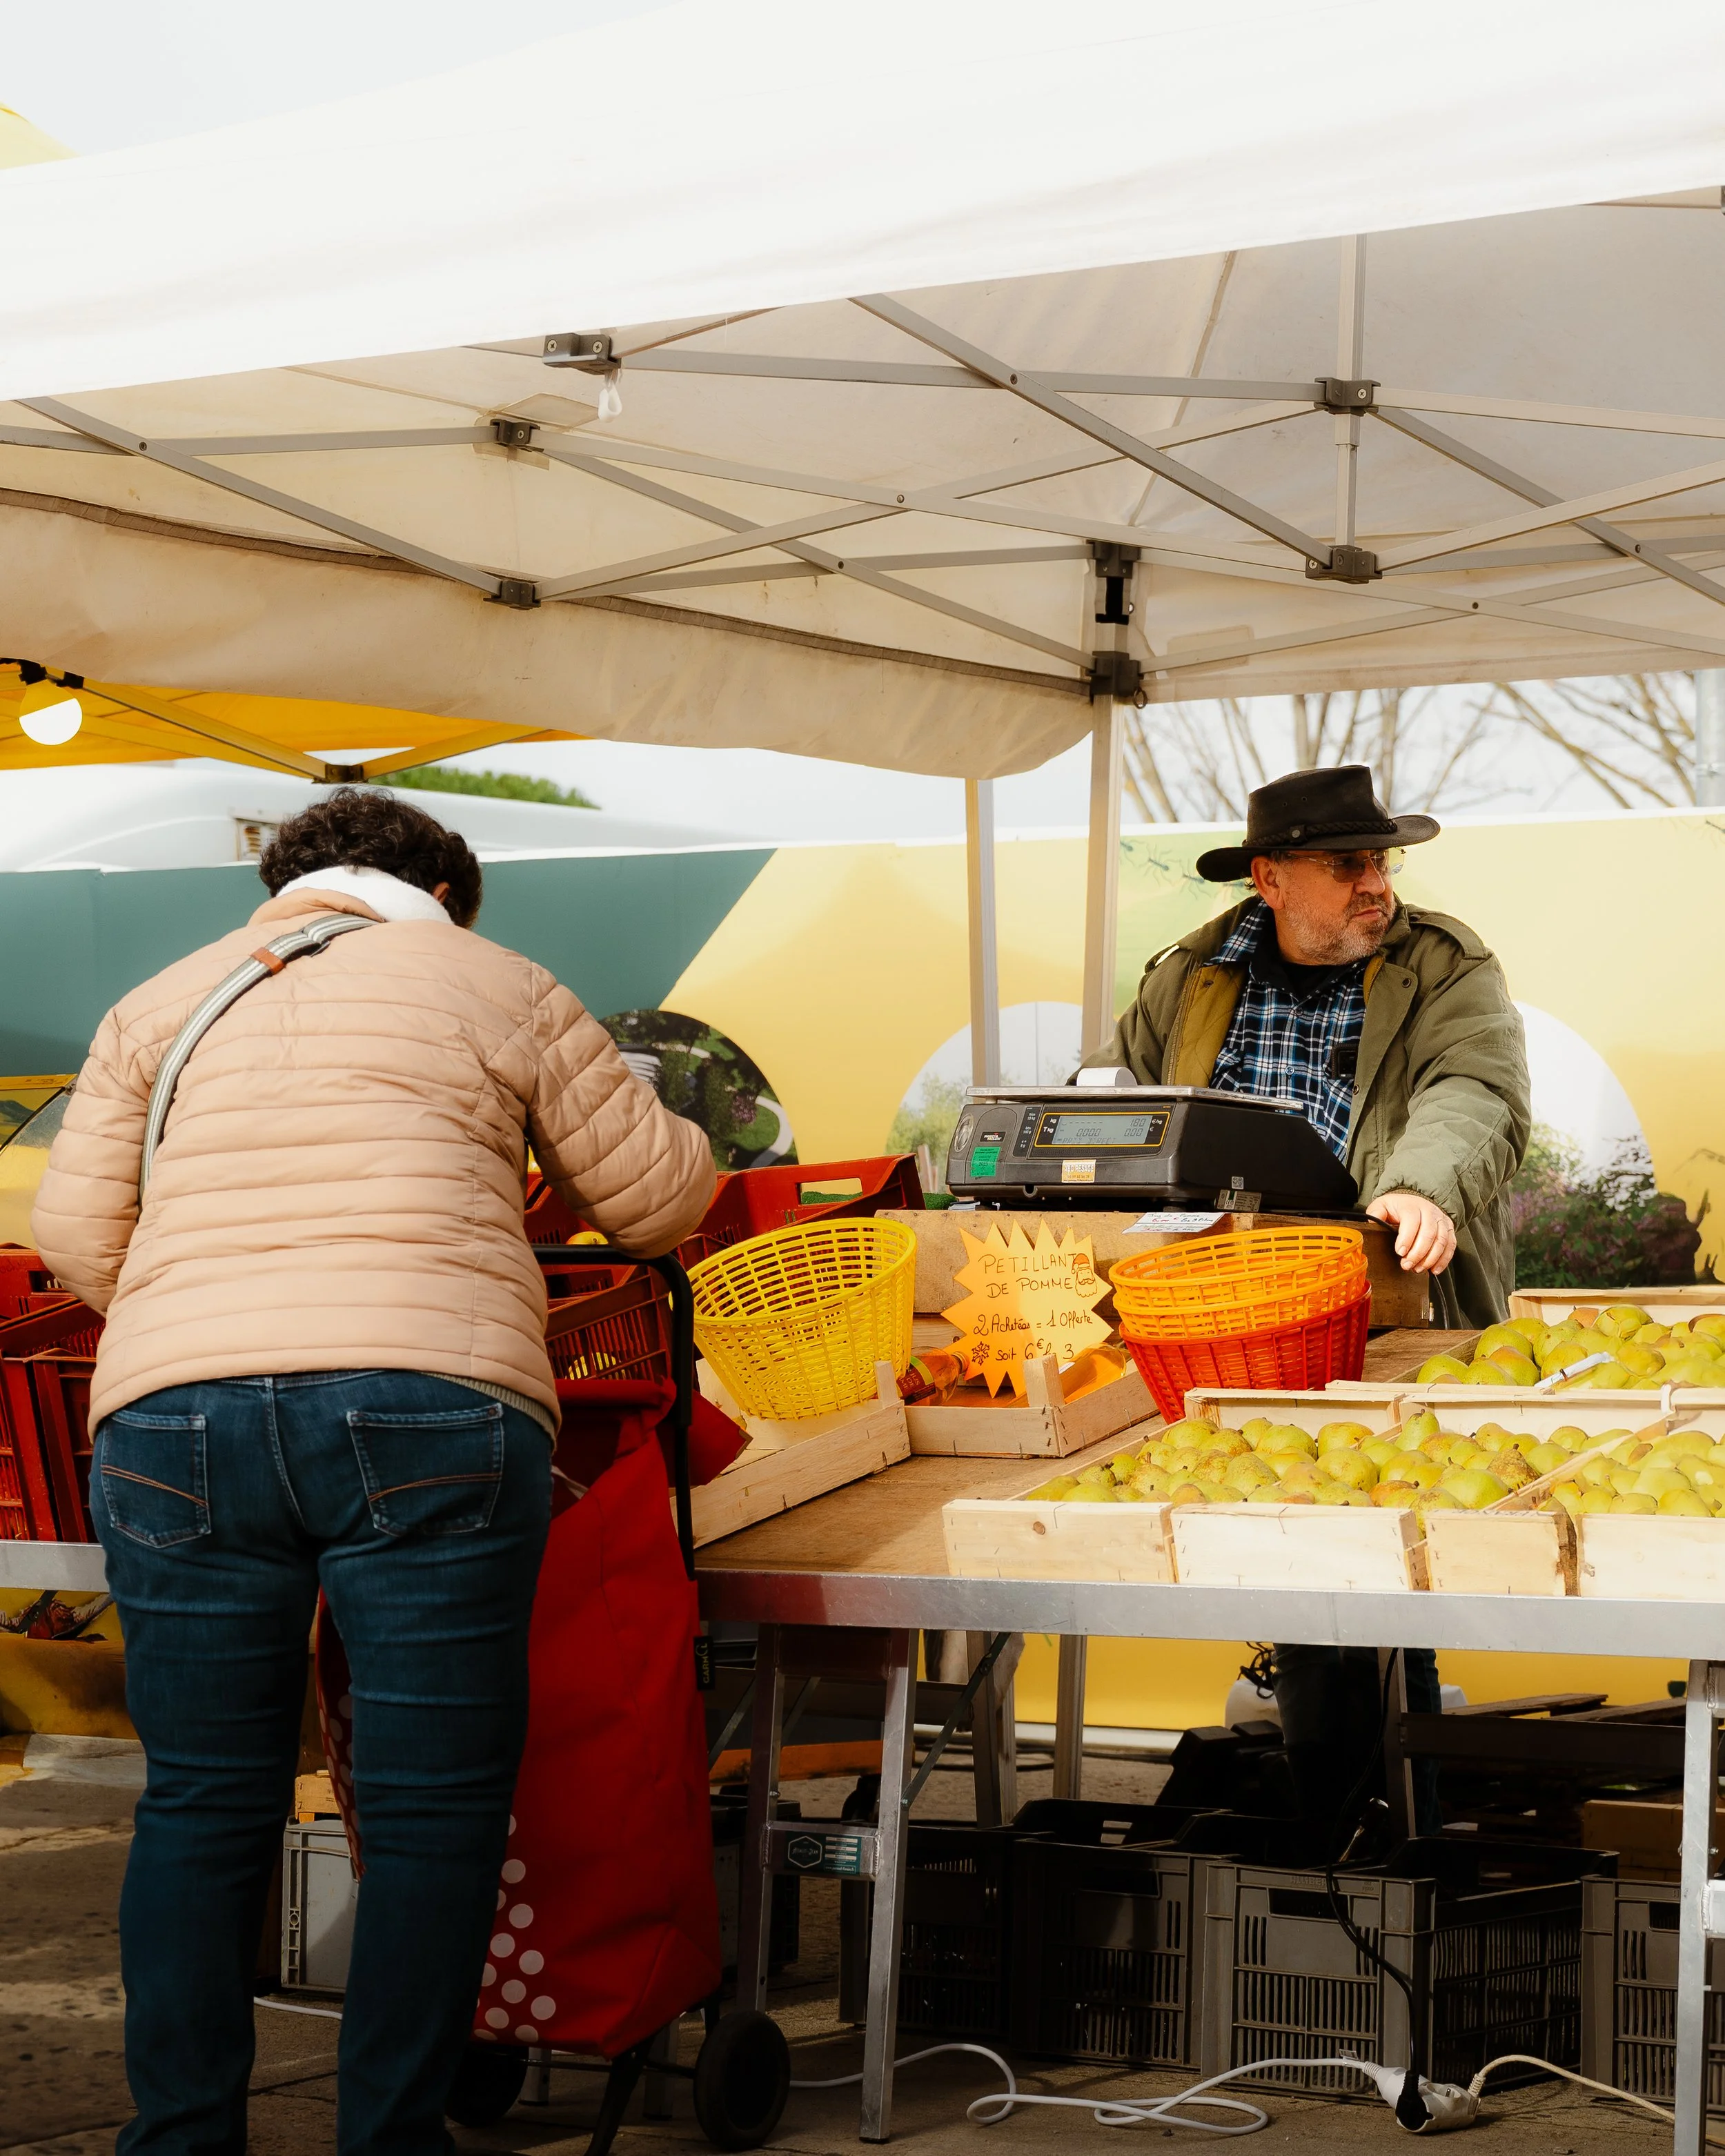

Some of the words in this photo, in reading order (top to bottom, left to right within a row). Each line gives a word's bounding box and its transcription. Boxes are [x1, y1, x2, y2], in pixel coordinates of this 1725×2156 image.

[978, 1253, 1077, 1274] PETILLANT
[986, 1283, 1009, 1298] DE
[1016, 1277, 1073, 1292] POMME
[973, 1314, 989, 1336] 2
[1046, 1309, 1056, 1327] 1
[1060, 1309, 1093, 1329] Offerte
[1063, 1343, 1074, 1360] 3
[910, 1372, 920, 1385] JUS
